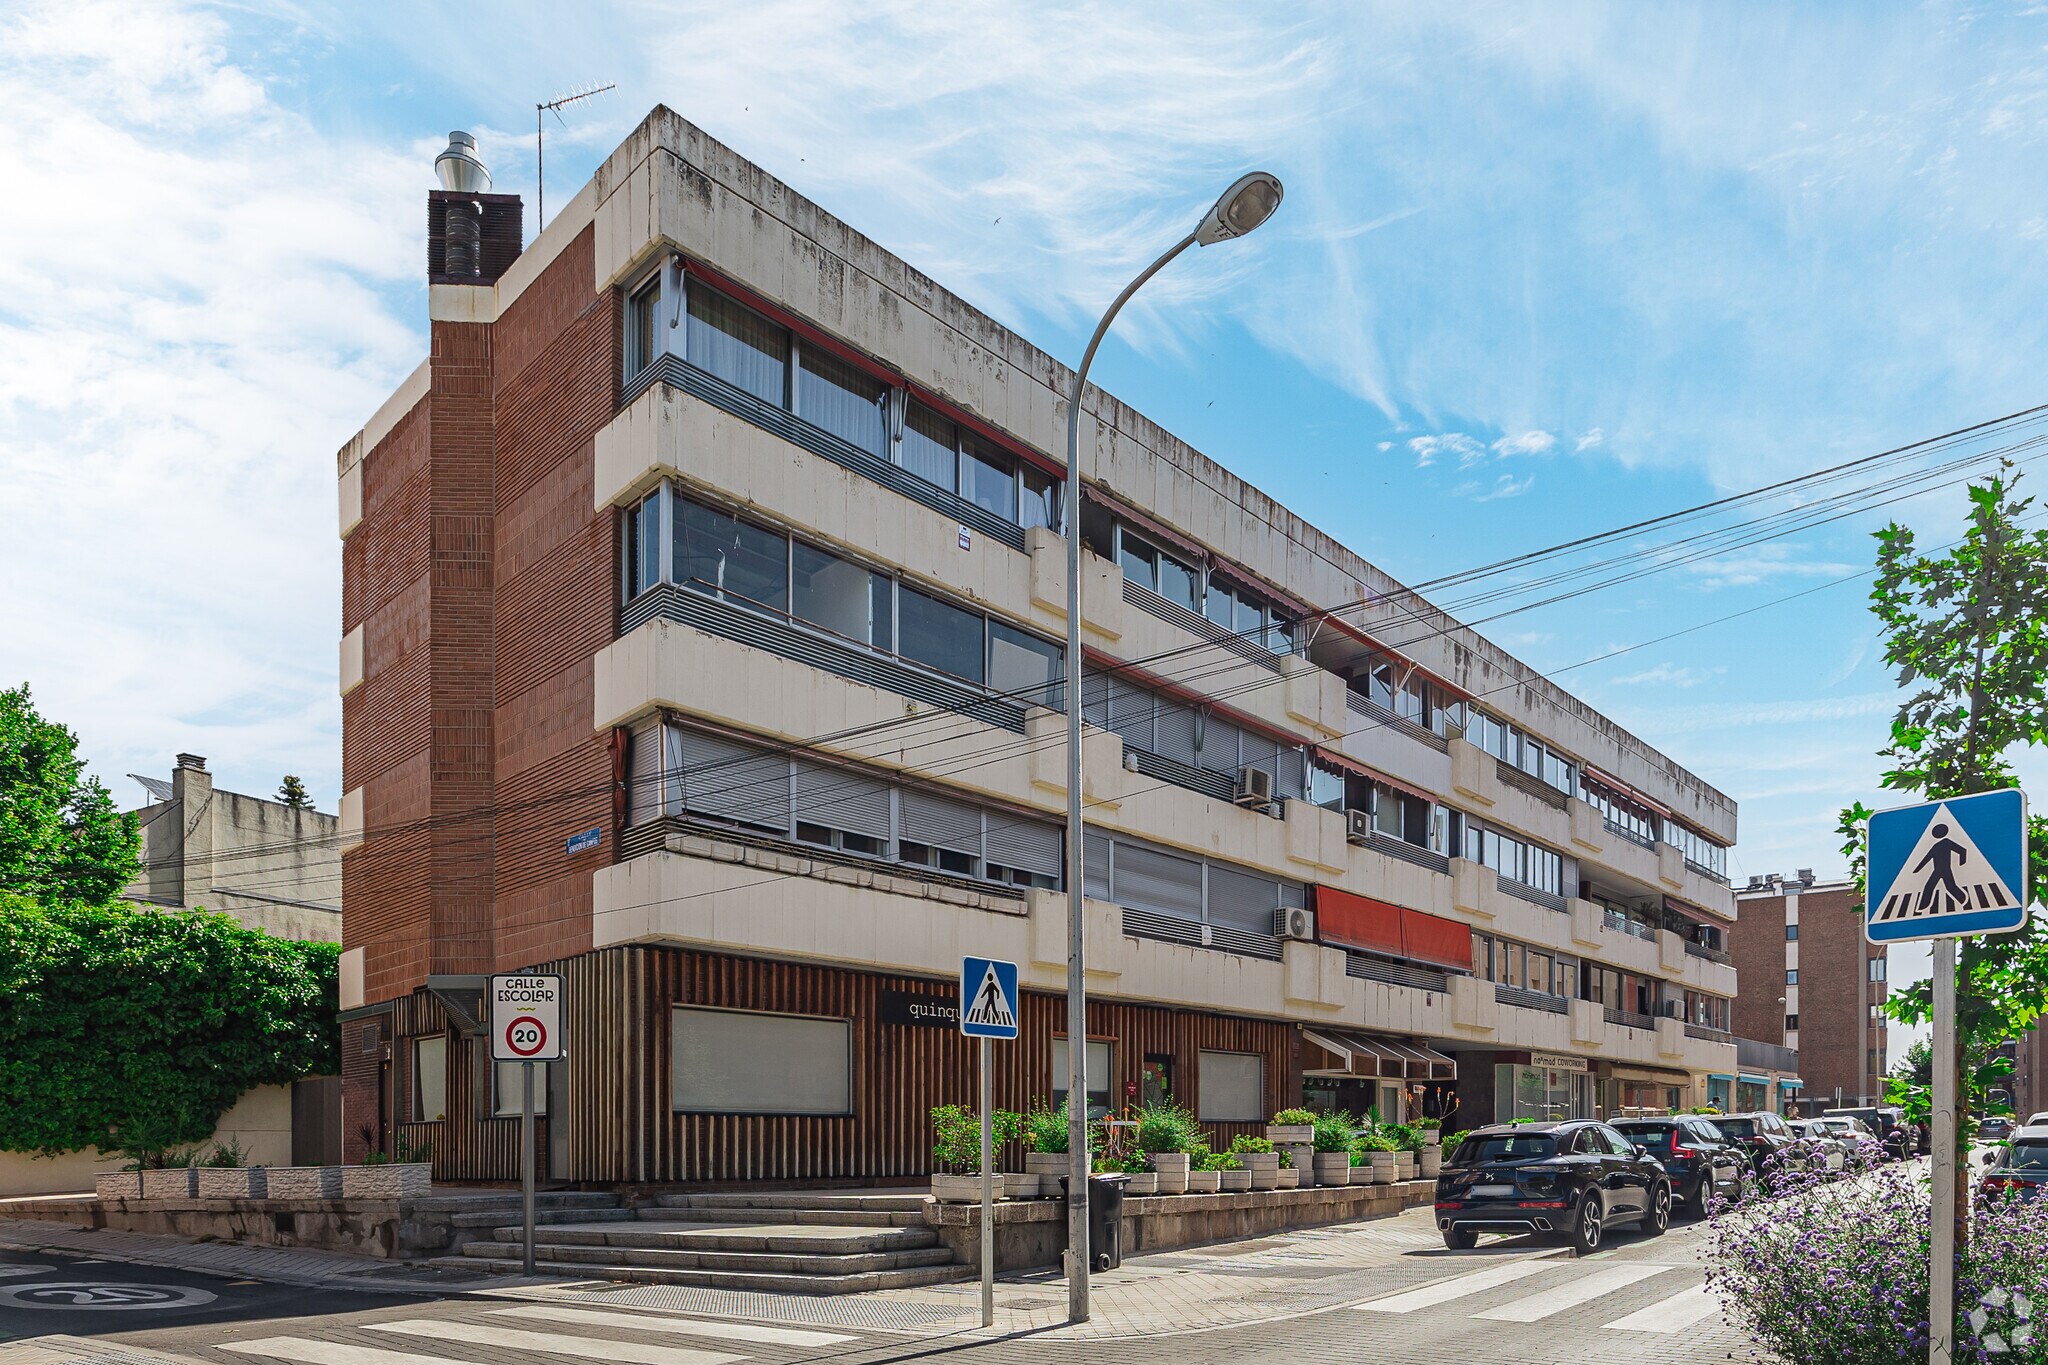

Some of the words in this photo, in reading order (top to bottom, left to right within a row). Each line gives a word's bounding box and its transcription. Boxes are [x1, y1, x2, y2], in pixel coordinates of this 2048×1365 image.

[506, 979, 545, 988] CALLE
[498, 990, 554, 1002] ESCOLAR
[515, 1029, 538, 1042] 20
[1557, 1058, 1586, 1068] COWORKING
